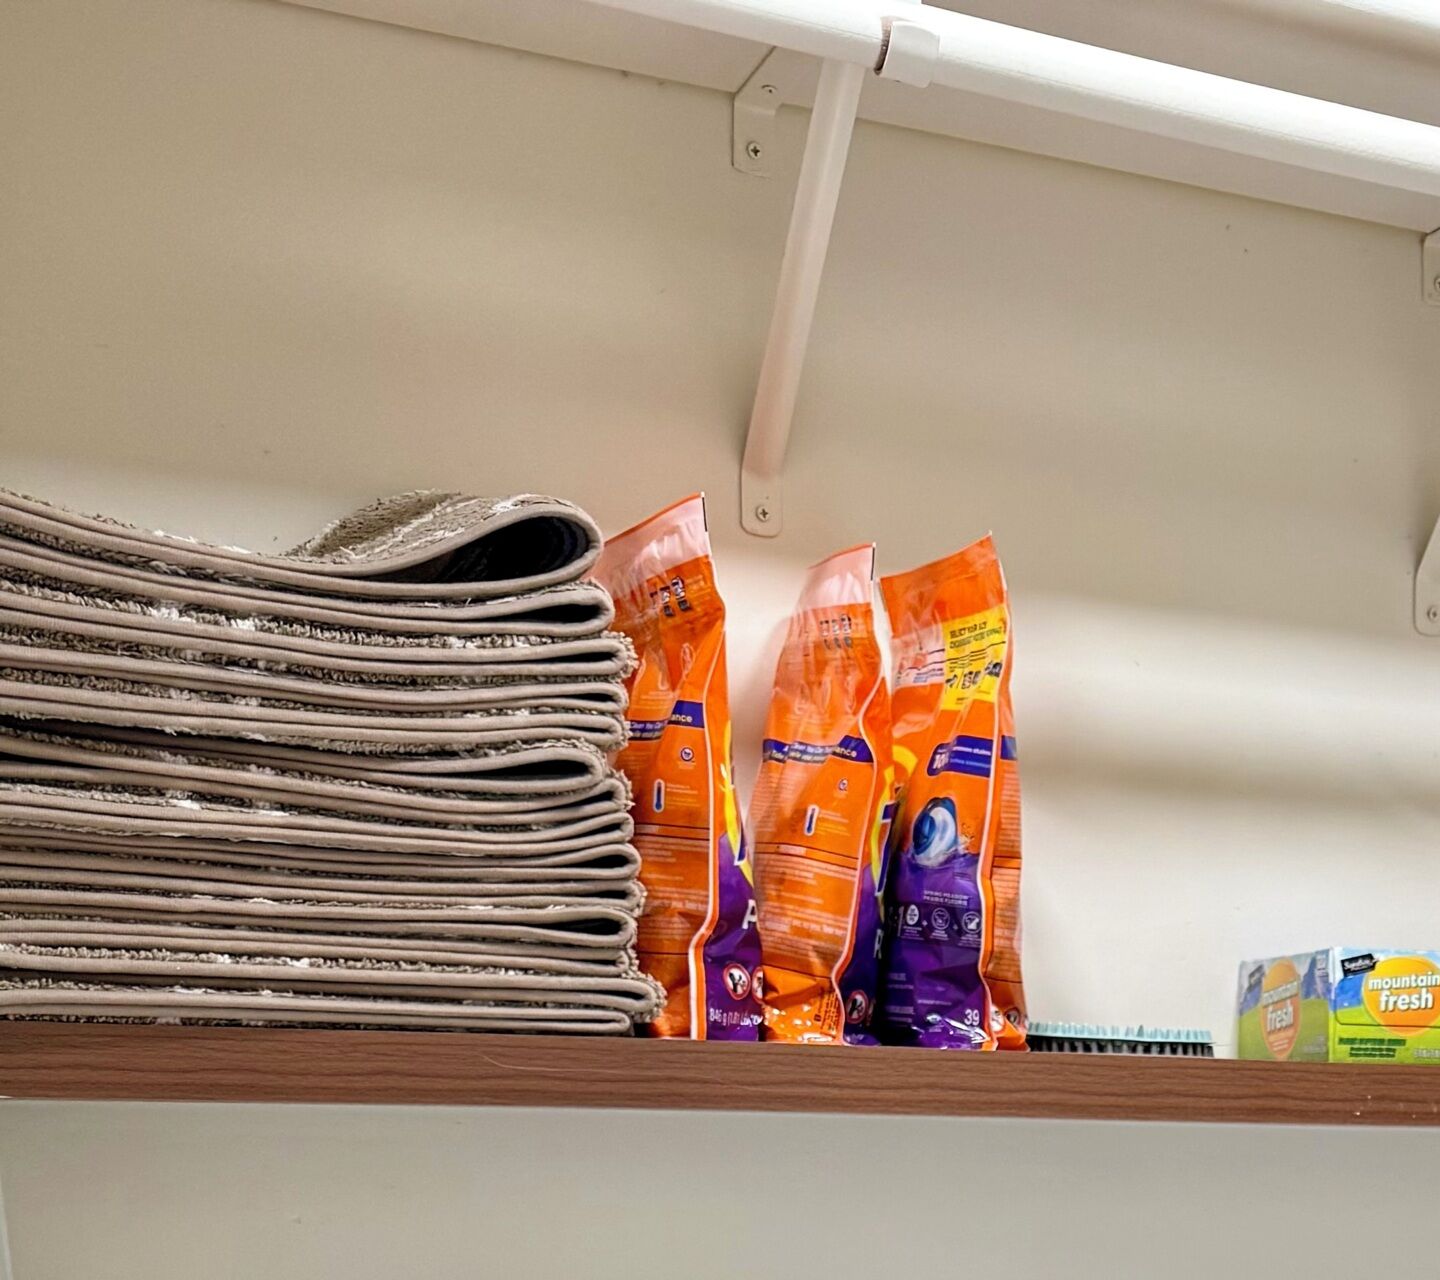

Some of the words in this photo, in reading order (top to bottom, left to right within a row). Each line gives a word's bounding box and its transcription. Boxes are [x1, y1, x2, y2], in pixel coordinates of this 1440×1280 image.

[1380, 989, 1434, 1013] fresh
[964, 1009, 980, 1026] 39
[1267, 1000, 1294, 1033] fresh
